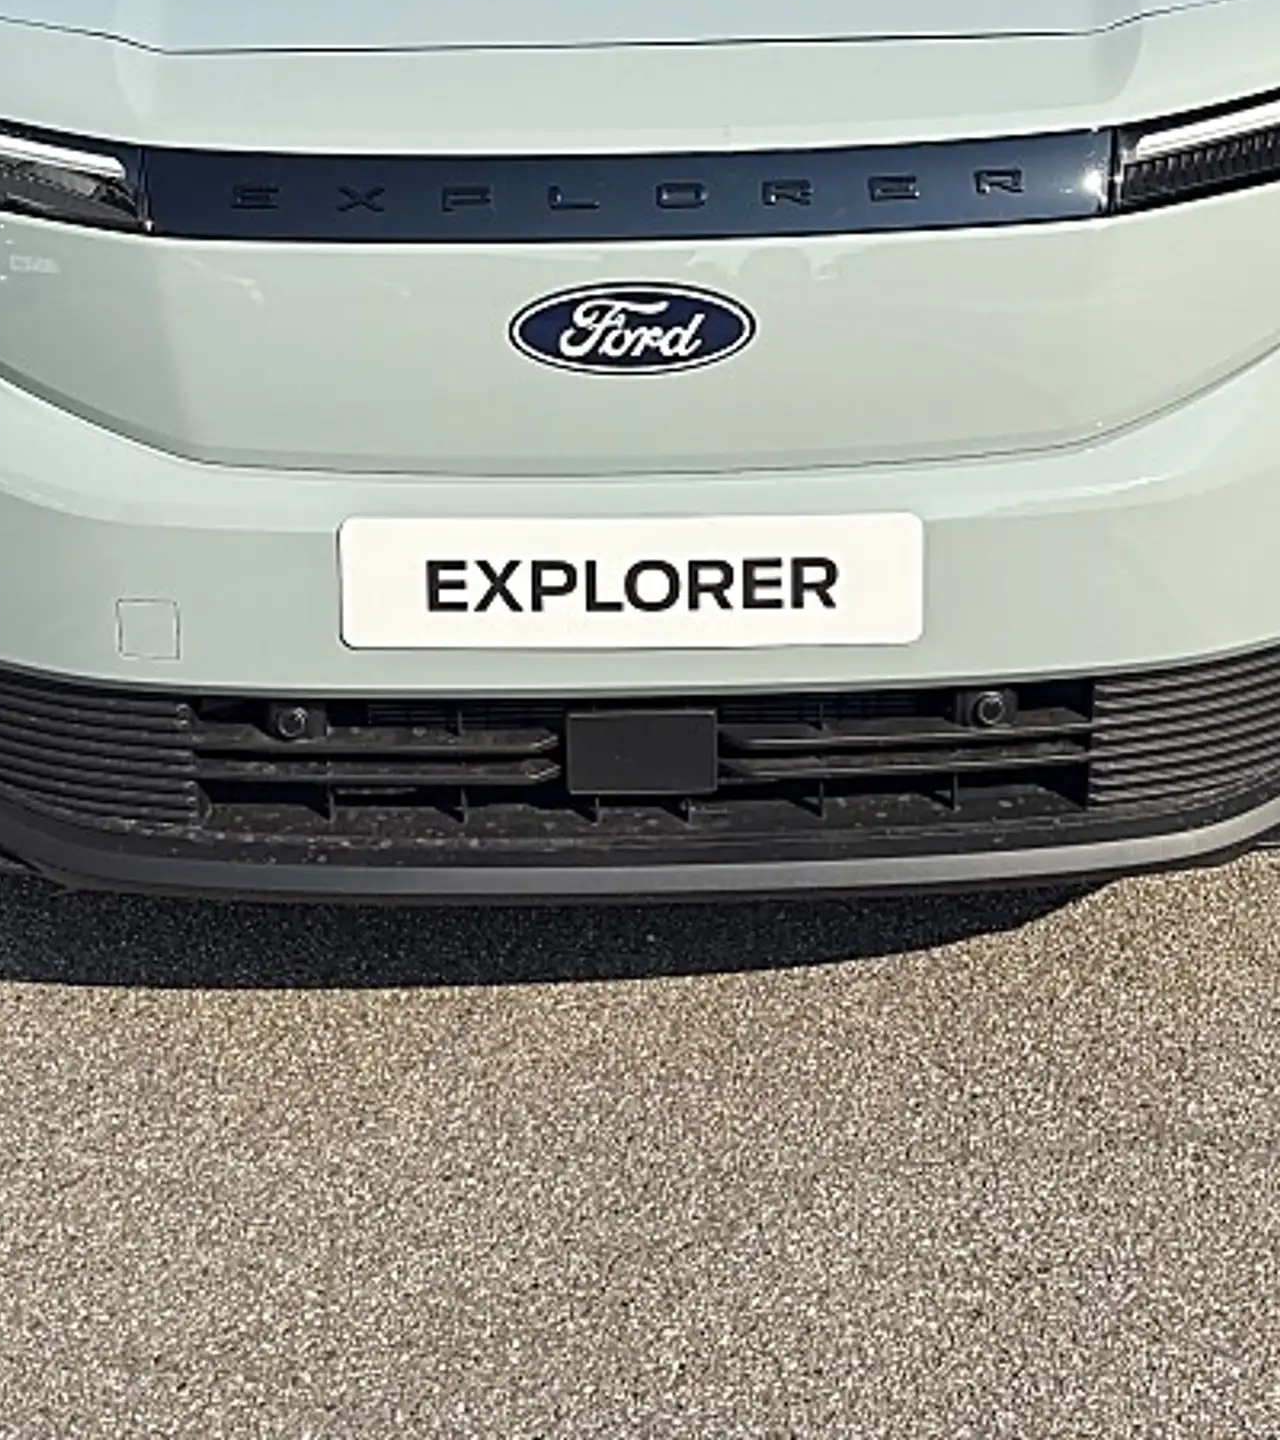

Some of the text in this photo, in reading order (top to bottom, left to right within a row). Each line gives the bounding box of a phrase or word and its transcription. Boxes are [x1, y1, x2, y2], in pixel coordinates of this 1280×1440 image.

[231, 169, 1025, 213] EXPLORER
[560, 299, 706, 357] Ford
[425, 557, 839, 612] EXPLORER
